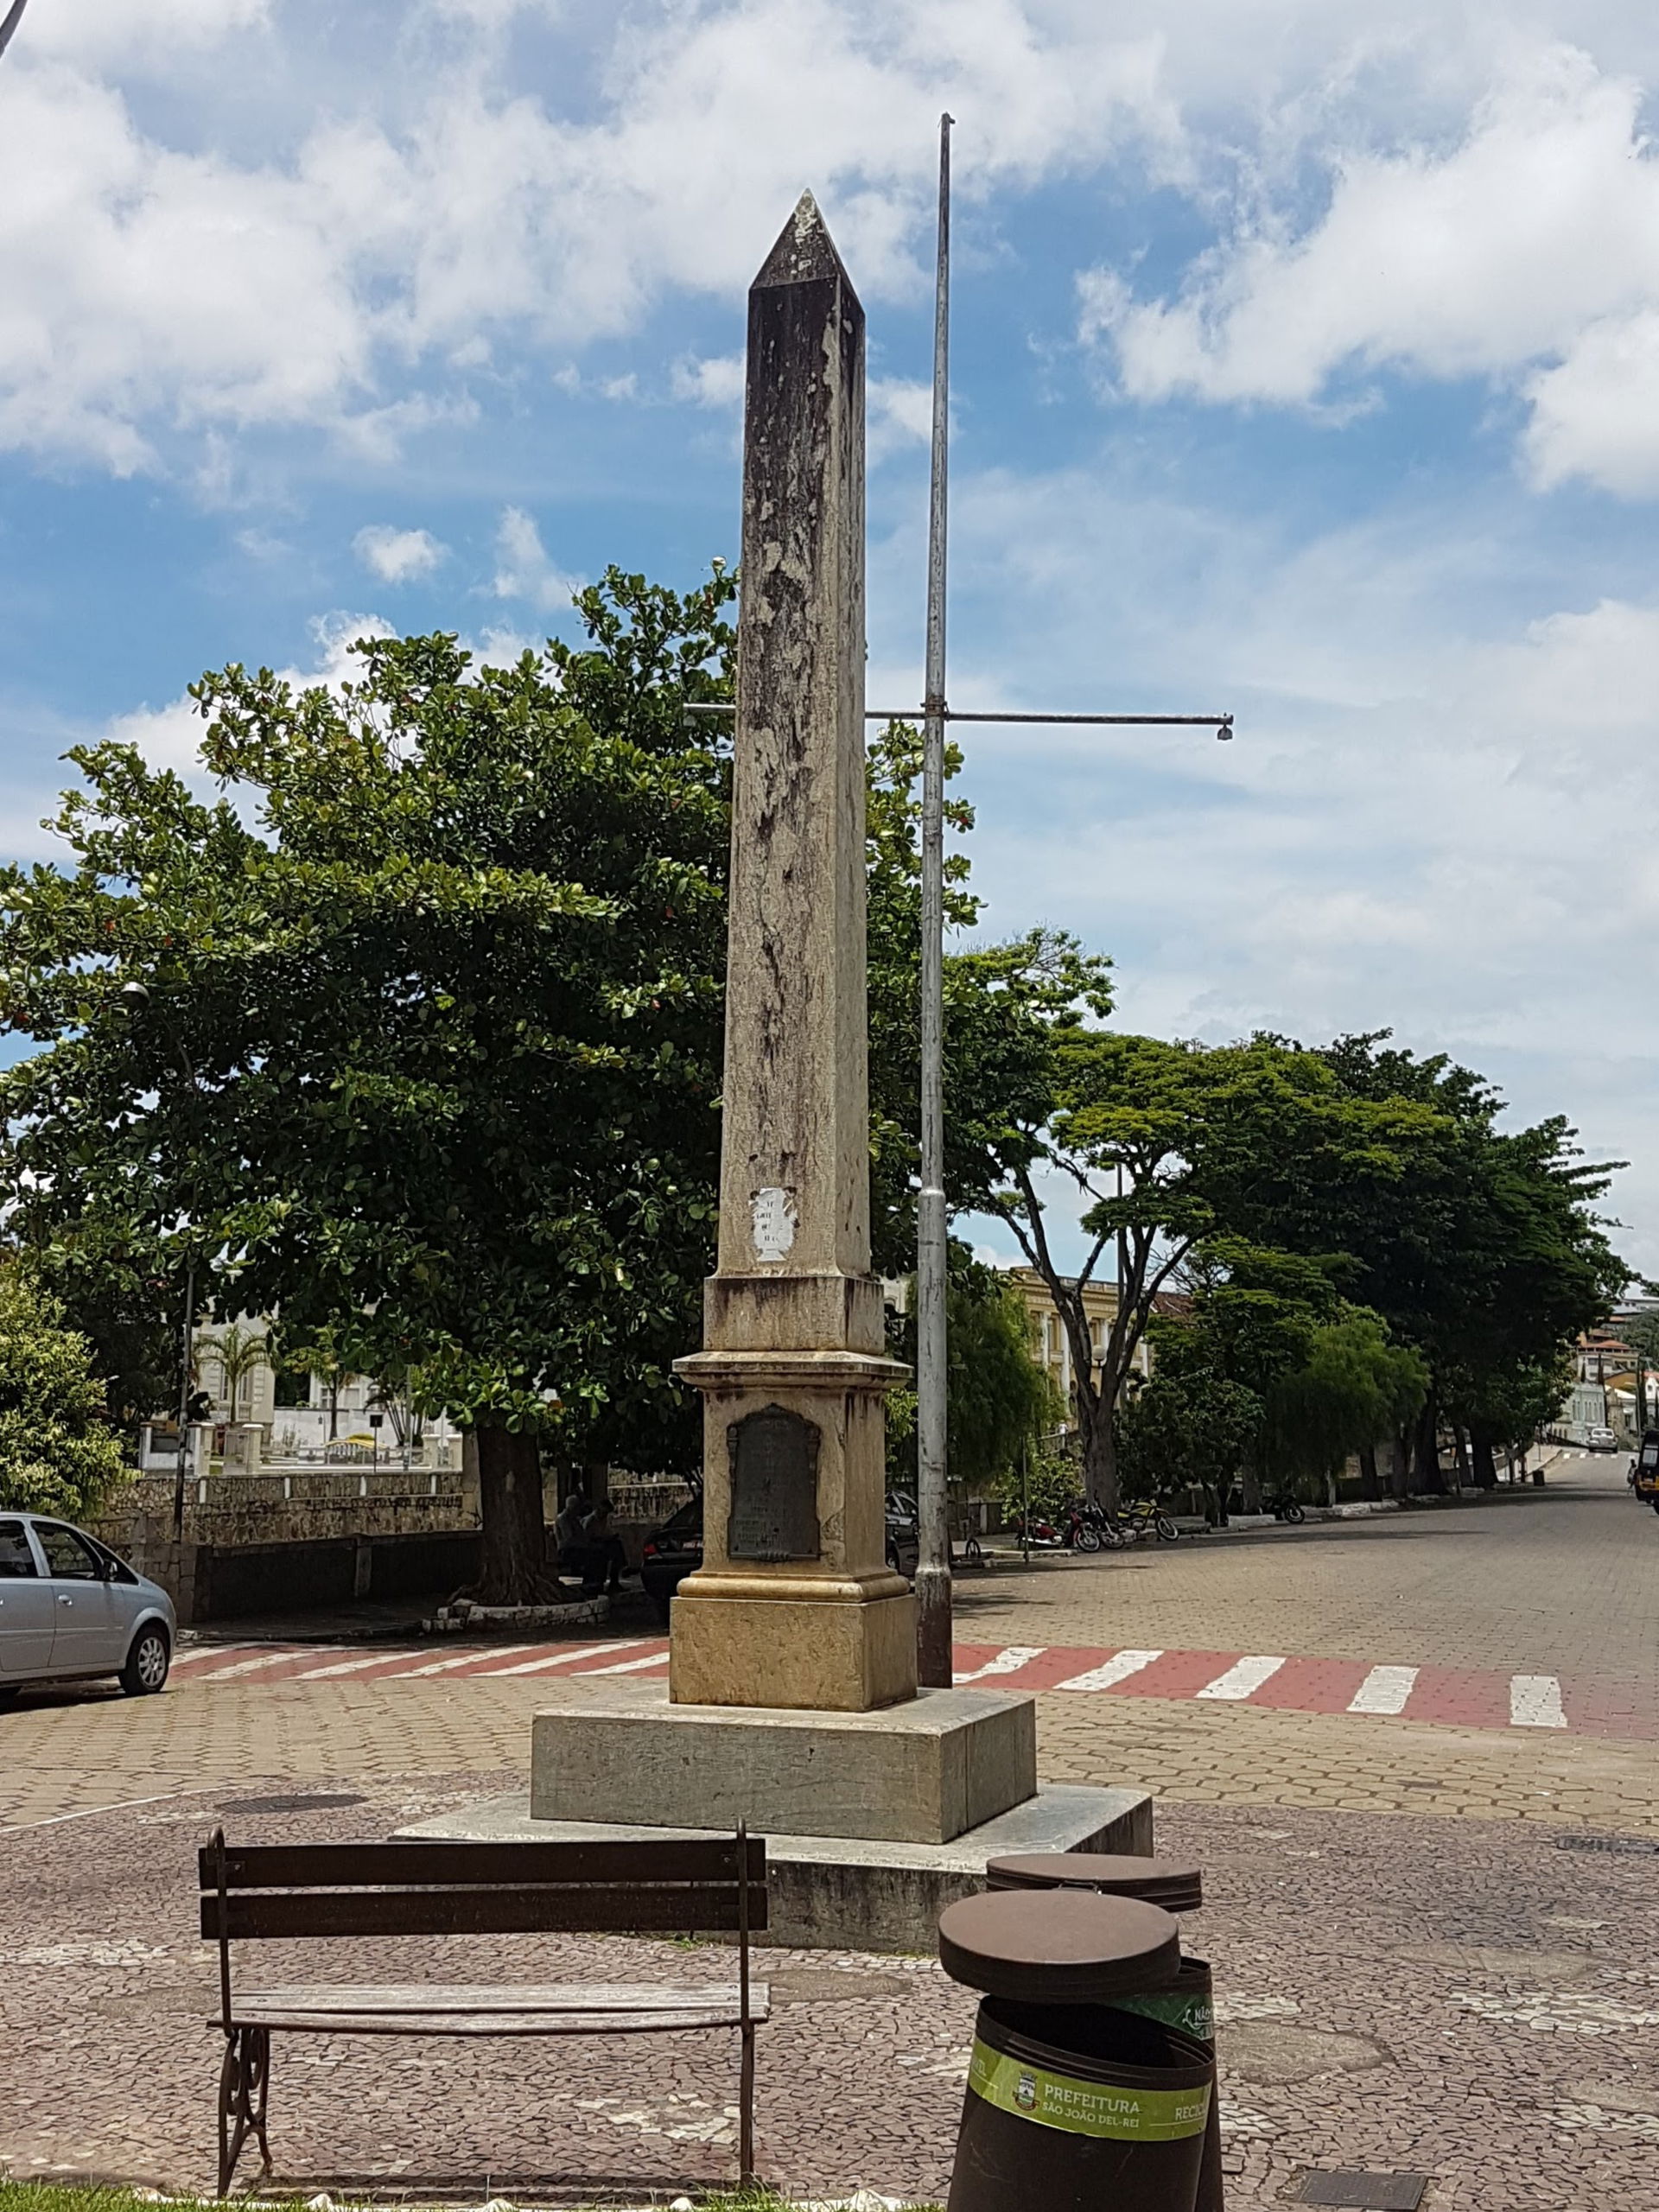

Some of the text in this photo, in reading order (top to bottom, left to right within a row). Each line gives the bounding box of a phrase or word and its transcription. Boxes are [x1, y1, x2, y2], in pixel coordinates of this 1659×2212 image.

[1045, 2083, 1140, 2113] PREFEITURA
[1042, 2101, 1139, 2127] SÃO JOÃO DEL-REI
